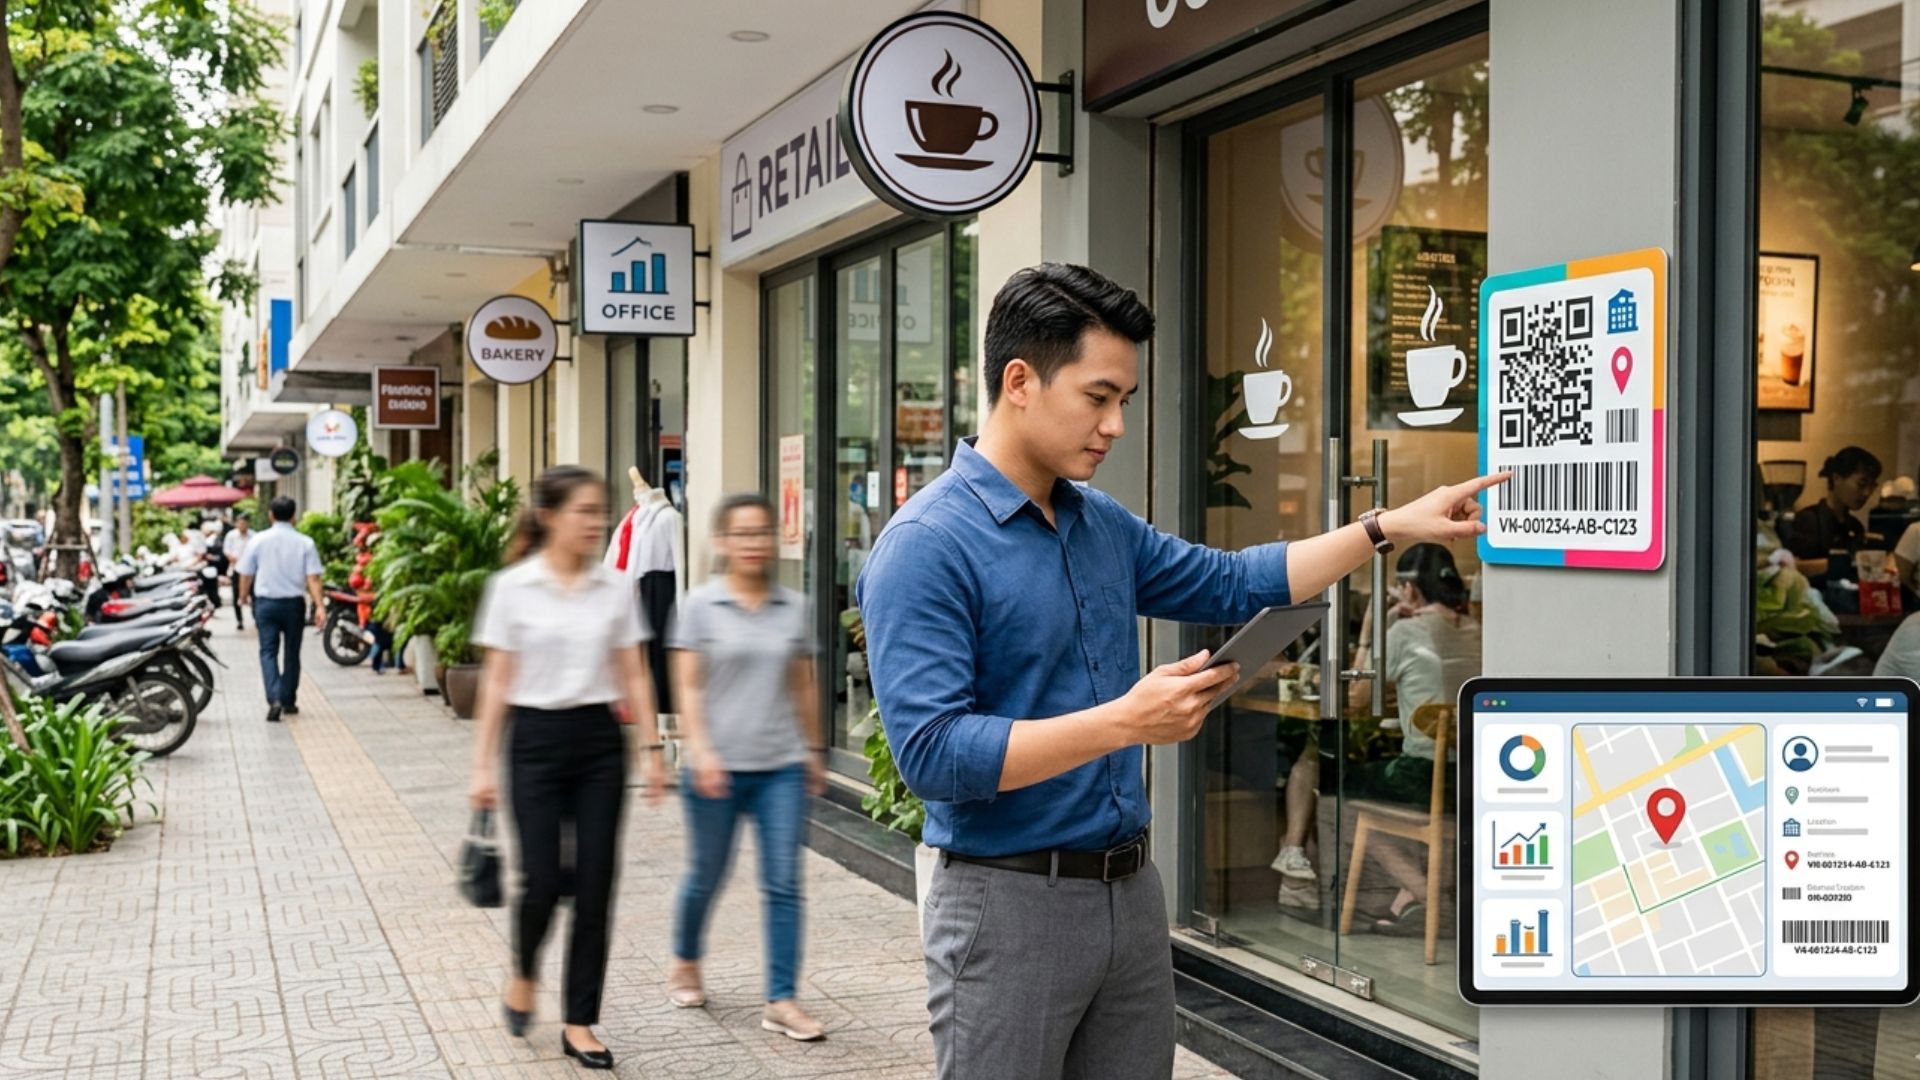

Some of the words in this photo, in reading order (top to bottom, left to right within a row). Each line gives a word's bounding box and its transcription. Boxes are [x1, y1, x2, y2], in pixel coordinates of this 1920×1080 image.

[759, 113, 850, 219] RETAIL
[602, 303, 676, 321] OFFICE
[481, 347, 545, 361] BAKERY
